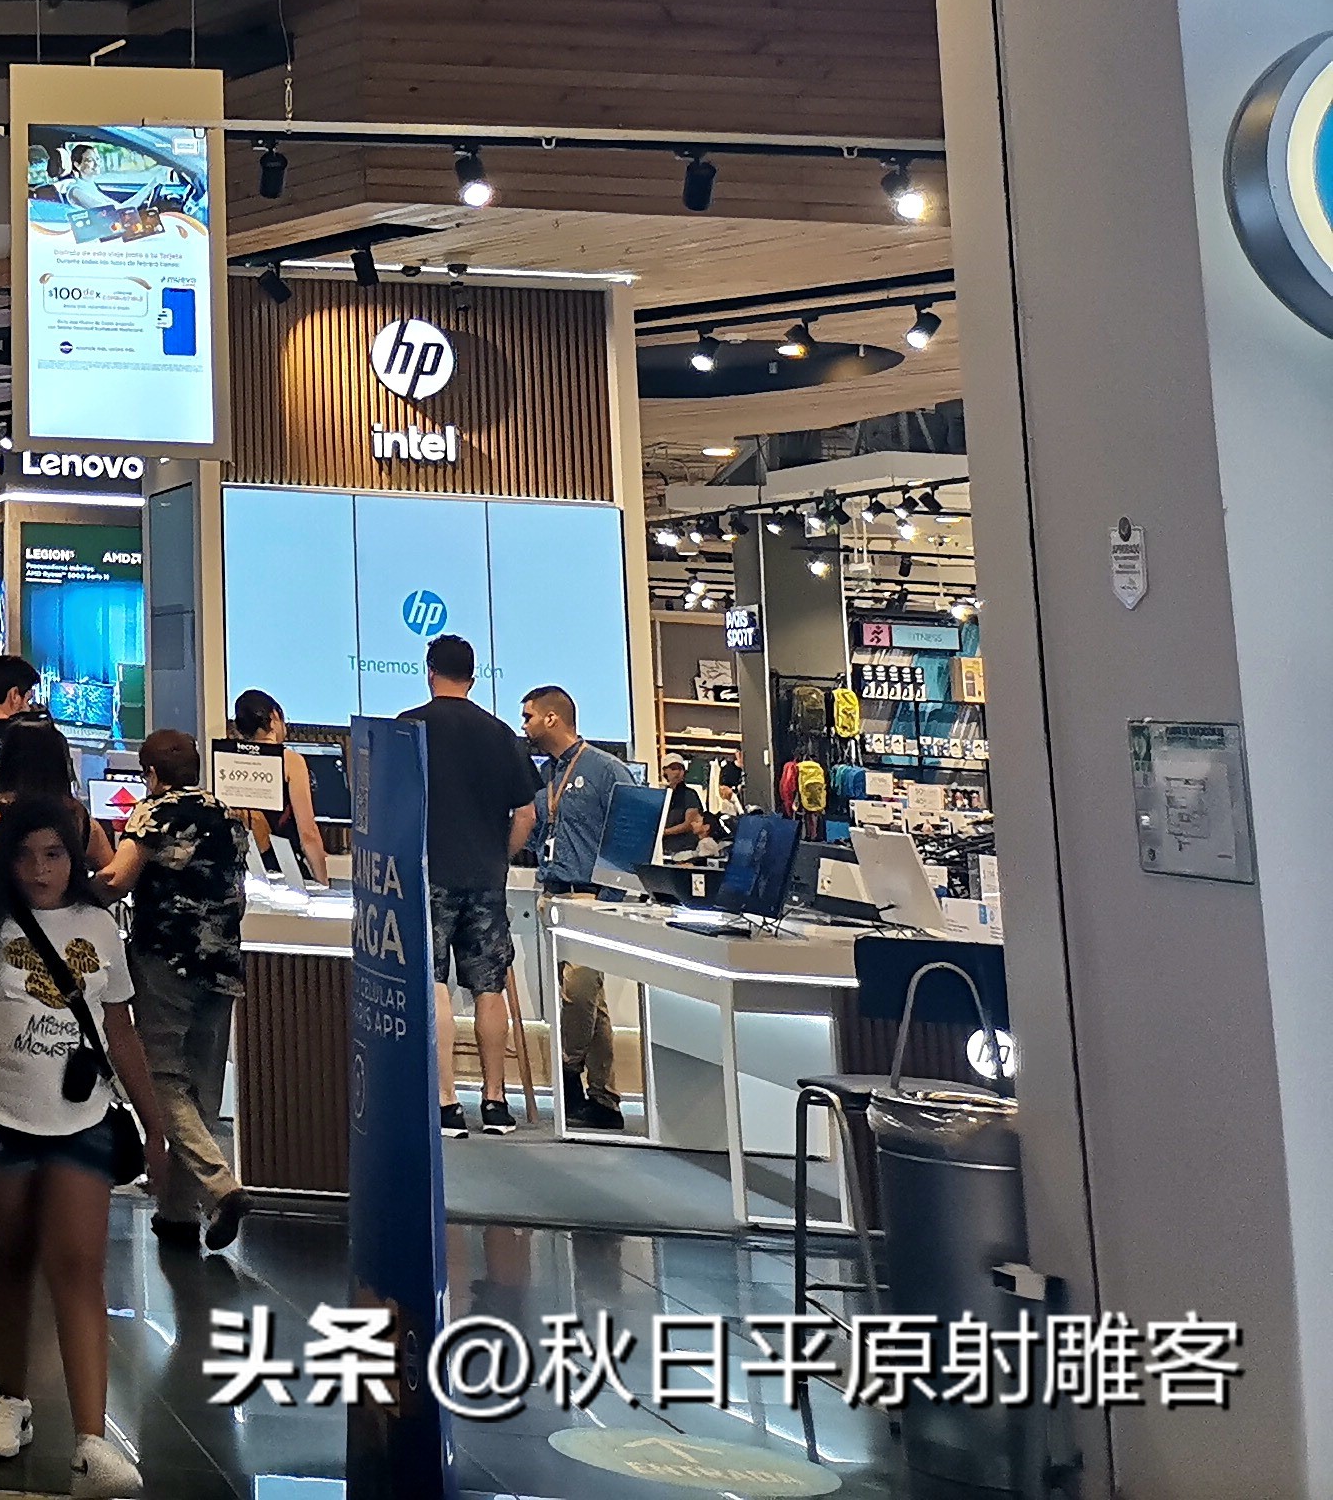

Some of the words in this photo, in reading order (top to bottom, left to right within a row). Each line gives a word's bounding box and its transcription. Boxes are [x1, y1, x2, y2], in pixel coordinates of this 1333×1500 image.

[379, 319, 449, 401] hp
[372, 423, 460, 463] intel
[22, 451, 144, 480] Lenovo
[25, 547, 71, 562] LEGION
[102, 552, 130, 564] AMD
[406, 590, 445, 637] hp
[347, 655, 419, 676] Tenemos
